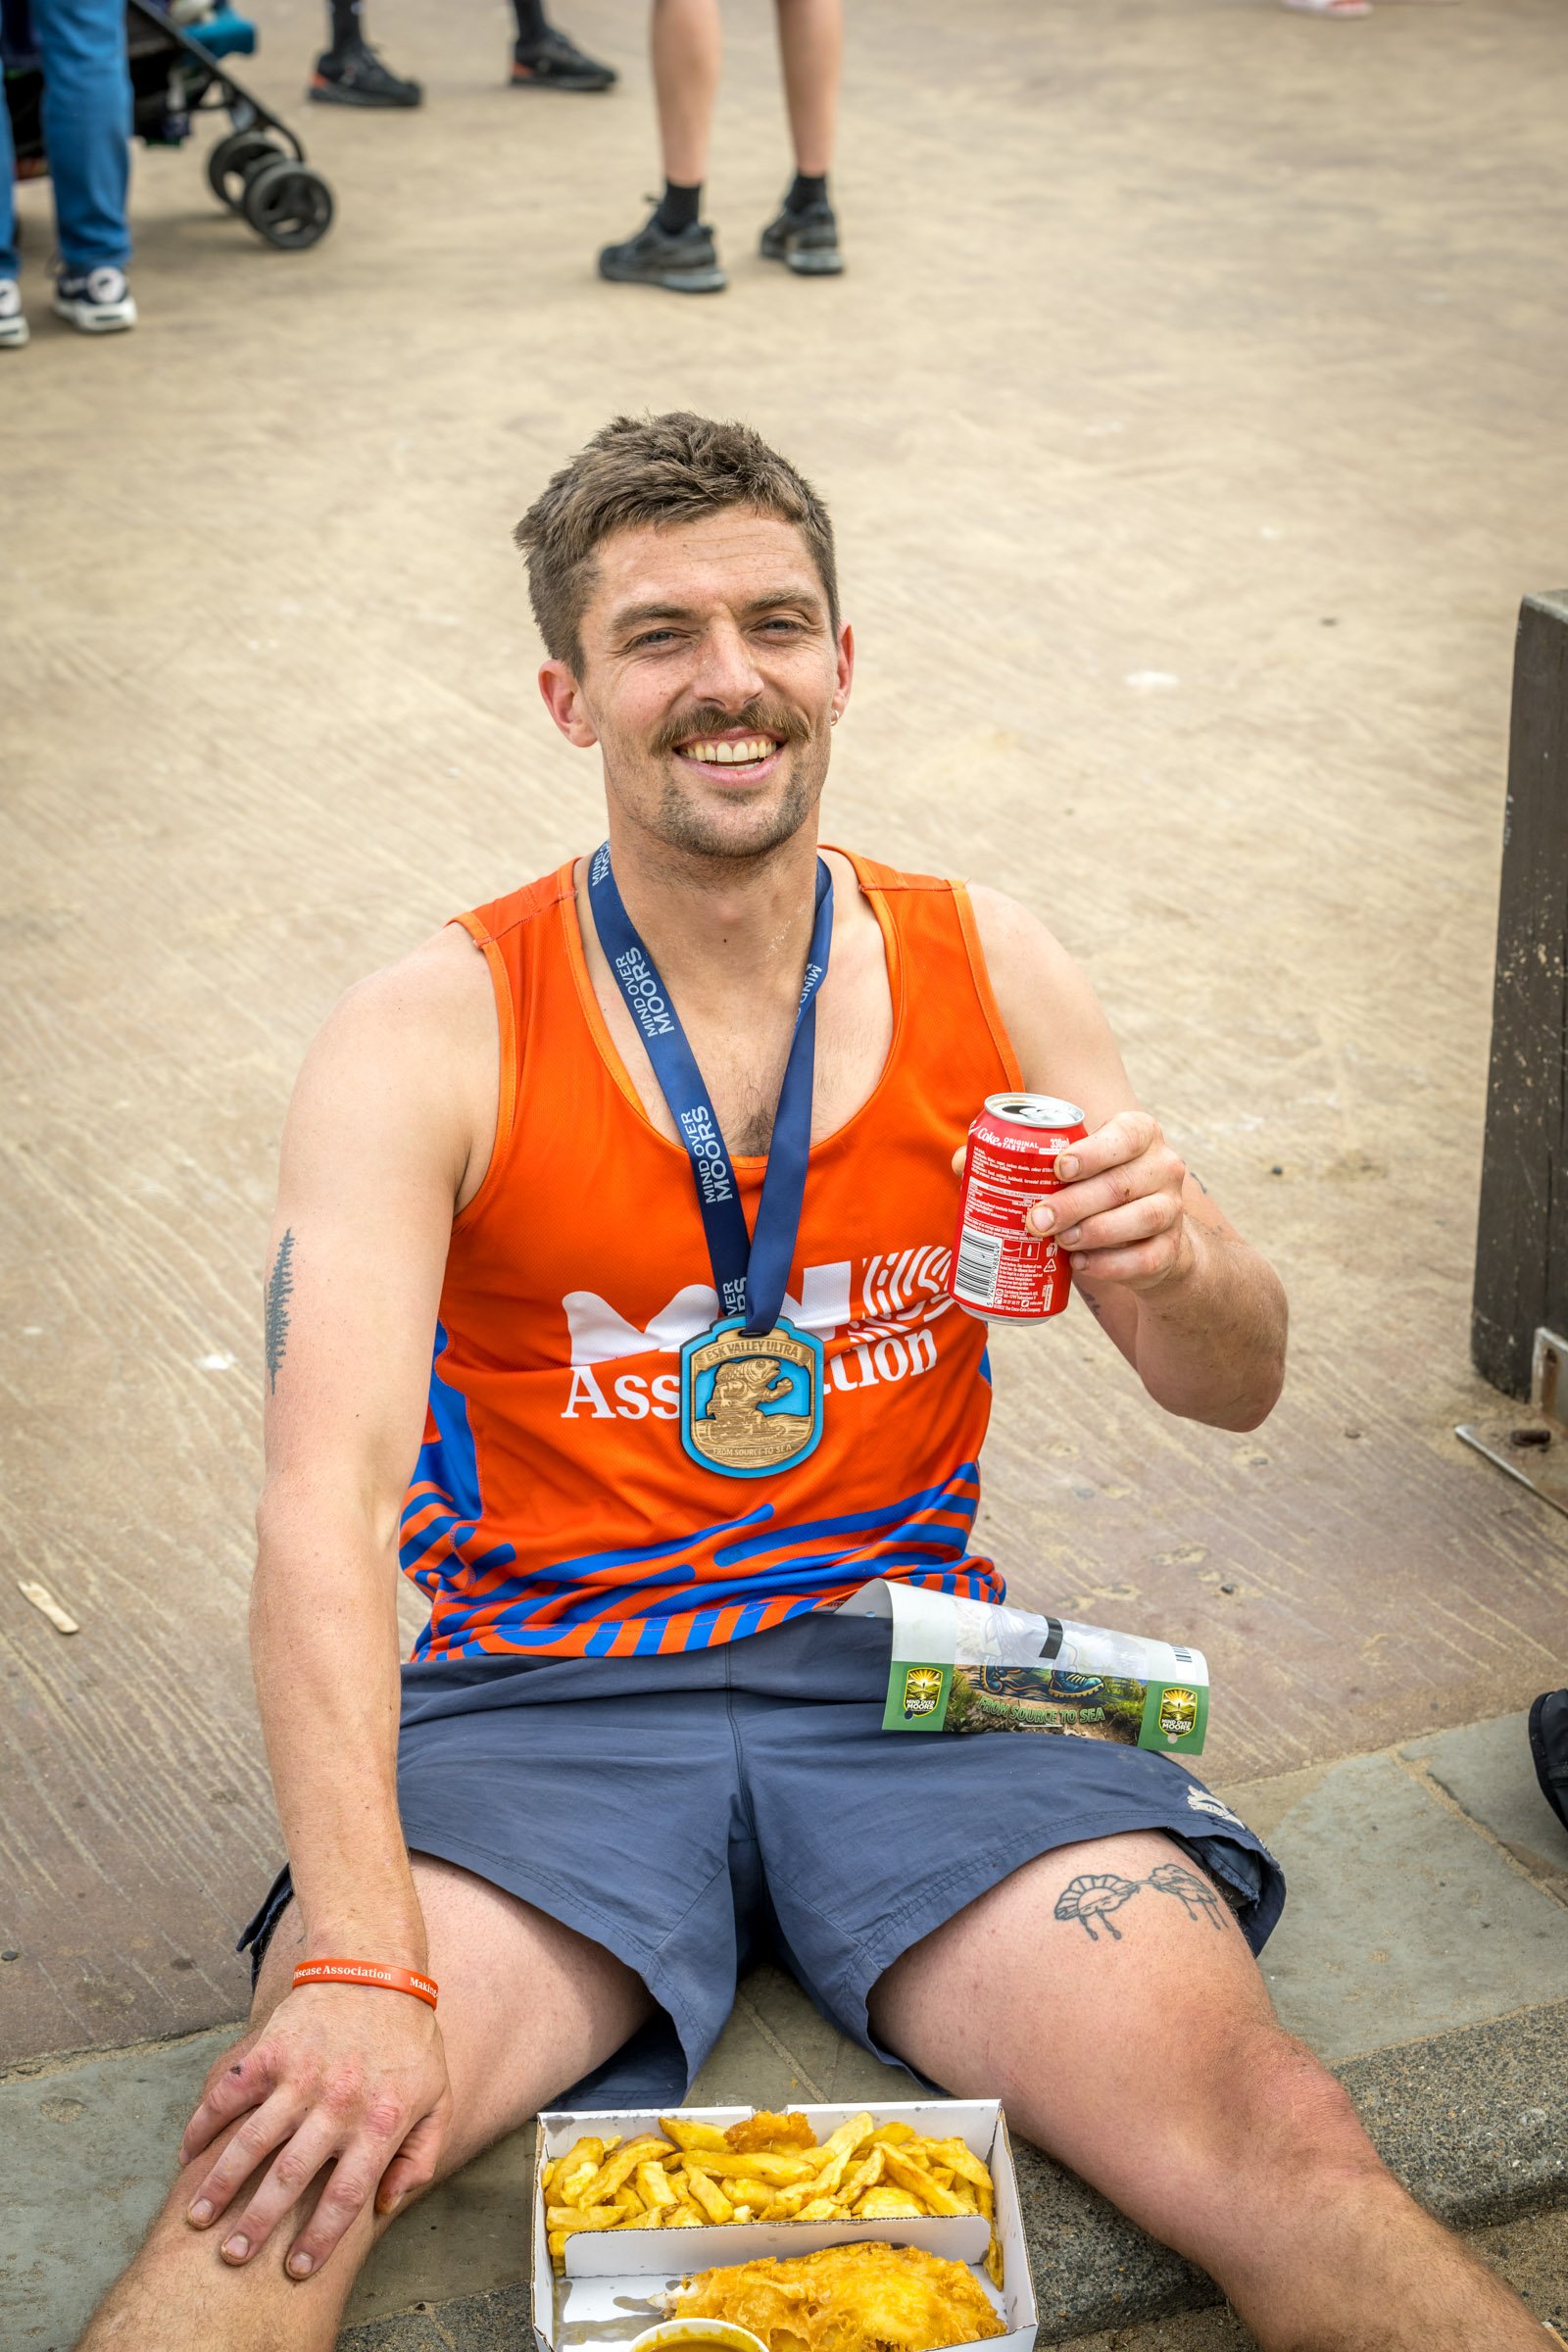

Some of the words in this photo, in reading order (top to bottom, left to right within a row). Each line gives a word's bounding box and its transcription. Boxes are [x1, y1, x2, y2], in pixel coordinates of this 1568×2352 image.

[592, 853, 604, 887] MIND
[615, 956, 640, 996] OVER
[625, 947, 675, 1035] MOORS
[800, 964, 823, 1004] MIND
[633, 998, 659, 1038] MIND
[680, 1110, 706, 1156] OVER
[977, 1127, 1001, 1147] Coke
[1002, 1143, 1026, 1152] TASTE
[1004, 1137, 1040, 1150] ORIGINAL
[691, 1105, 733, 1202] MOORS
[698, 1159, 717, 1204] MIND
[723, 1281, 738, 1316] VER
[706, 1347, 727, 1362] ESK
[728, 1341, 764, 1354] VALLEY
[765, 1341, 798, 1358] ULTRA
[712, 1447, 733, 1456] FROM
[734, 1447, 761, 1456] SOURCE
[763, 1446, 774, 1455] TO
[776, 1444, 792, 1453] SEA
[977, 1695, 1010, 1718] FROM
[1009, 1705, 1057, 1724] SOURCE
[1060, 1709, 1077, 1724] TO
[1080, 1707, 1105, 1724] SEA
[322, 1965, 392, 1981] Association
